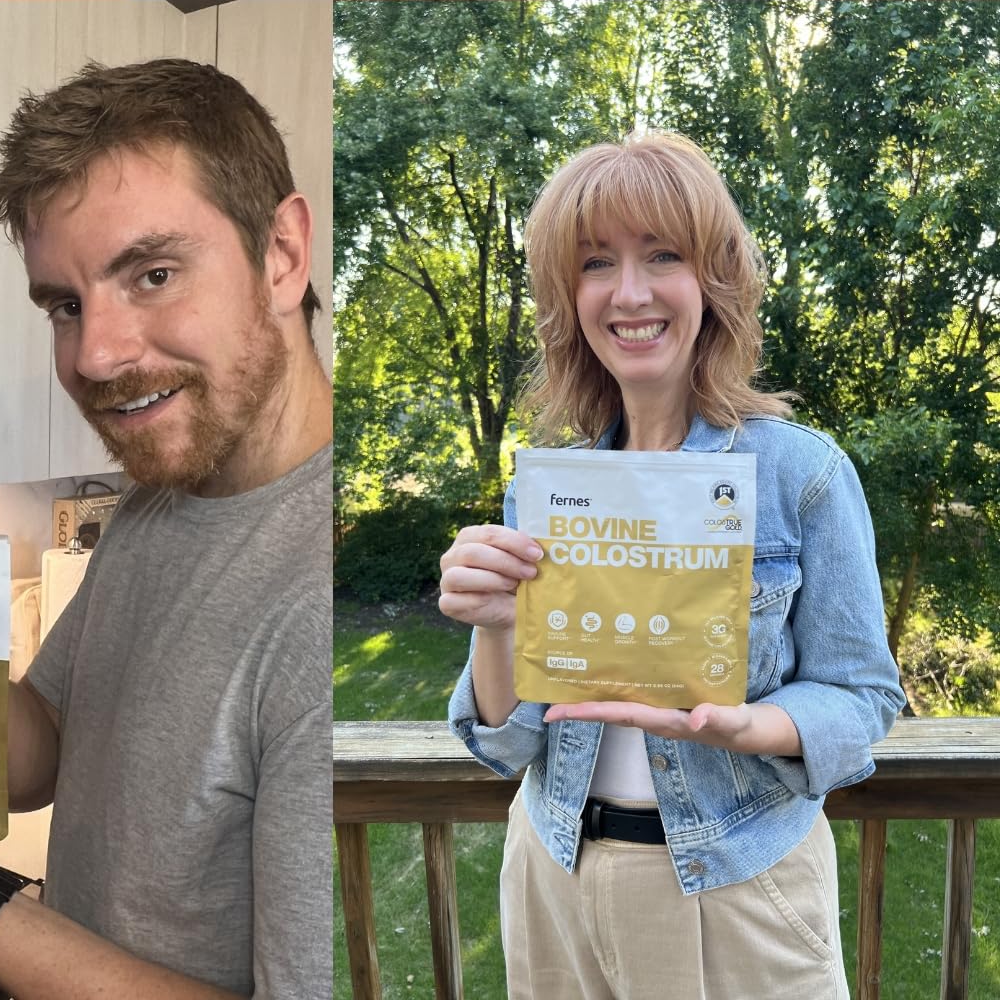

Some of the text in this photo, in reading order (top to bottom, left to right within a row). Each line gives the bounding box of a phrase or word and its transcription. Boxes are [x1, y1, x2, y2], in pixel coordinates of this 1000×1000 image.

[719, 486, 731, 496] 1ST
[550, 494, 590, 507] fernes
[549, 515, 657, 541] BOVINE
[550, 542, 728, 570] COLOSTRUM
[712, 624, 726, 634] 3G
[549, 658, 565, 668] IgG
[710, 664, 724, 673] 28
